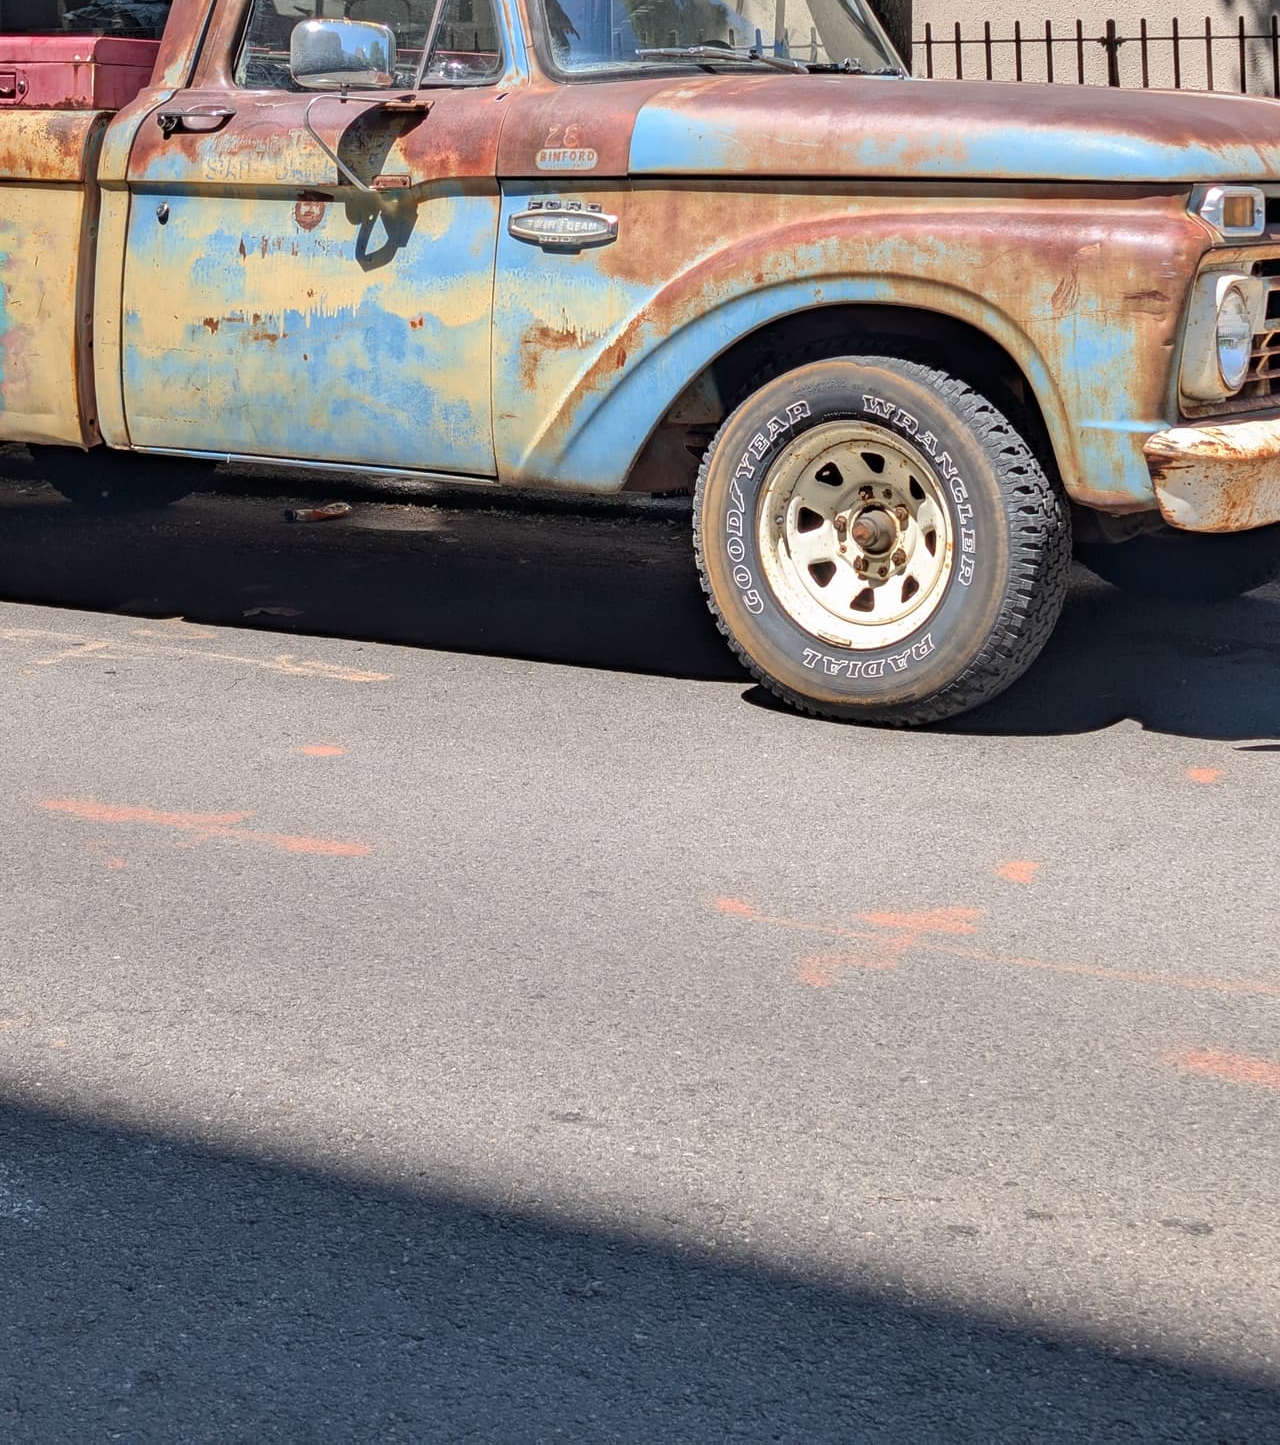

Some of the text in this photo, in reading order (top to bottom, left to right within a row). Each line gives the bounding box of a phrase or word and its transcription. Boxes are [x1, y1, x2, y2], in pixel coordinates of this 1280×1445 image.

[540, 149, 595, 163] BINFORD
[528, 199, 603, 212] FORD
[861, 394, 977, 589] WRANGLER
[802, 632, 937, 679] RADIAL
